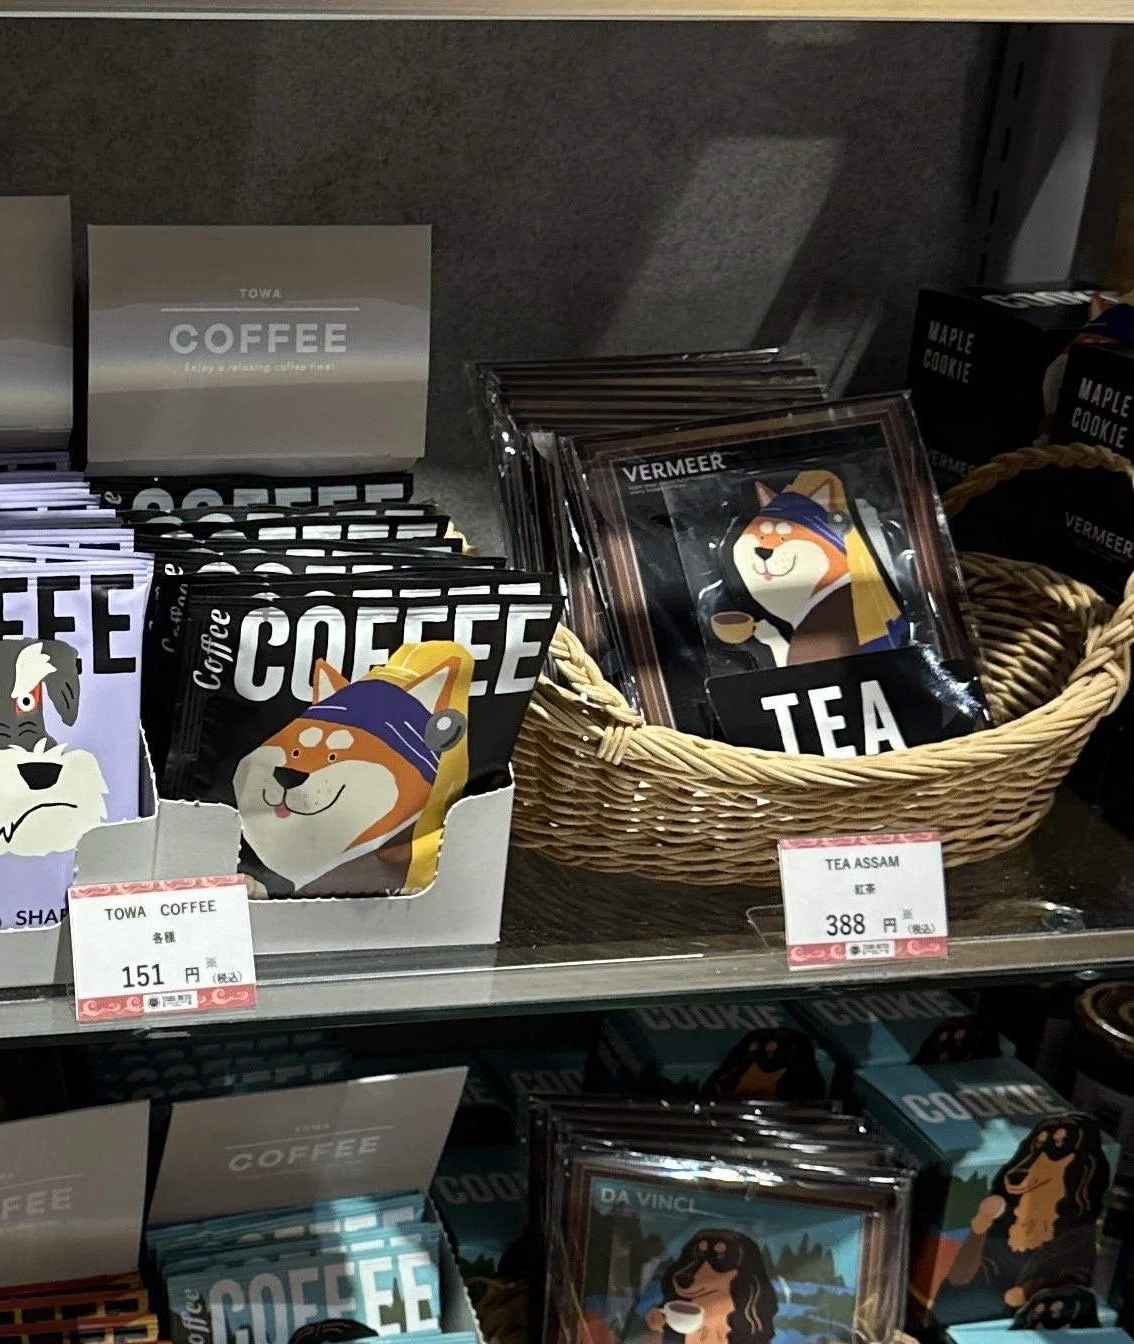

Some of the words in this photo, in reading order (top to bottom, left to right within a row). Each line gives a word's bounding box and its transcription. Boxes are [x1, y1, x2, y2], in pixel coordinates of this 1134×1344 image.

[239, 288, 282, 299] TOWA
[169, 323, 347, 354] COFFEE
[927, 320, 974, 355] MAPLE
[923, 348, 973, 384] COOKIE
[1077, 377, 1133, 418] MAPLE
[1071, 407, 1129, 449] COOKIE
[622, 452, 727, 482] VERMEER
[1065, 512, 1134, 559] VERMEER
[193, 608, 234, 692] Coffee
[761, 680, 909, 756] TEA
[826, 858, 851, 871] TEA
[854, 856, 900, 869] ASSAM
[105, 906, 147, 921] TOWA
[160, 899, 217, 917] COFFEE
[826, 913, 866, 936] 388
[883, 917, 897, 934] 円
[152, 931, 176, 945] 各種
[122, 963, 165, 988] 151
[185, 967, 200, 984] 円
[902, 1083, 1068, 1125] COOKIE
[228, 1134, 381, 1173] COFFEE
[601, 1187, 630, 1205] DA
[637, 1191, 696, 1214] VINCI
